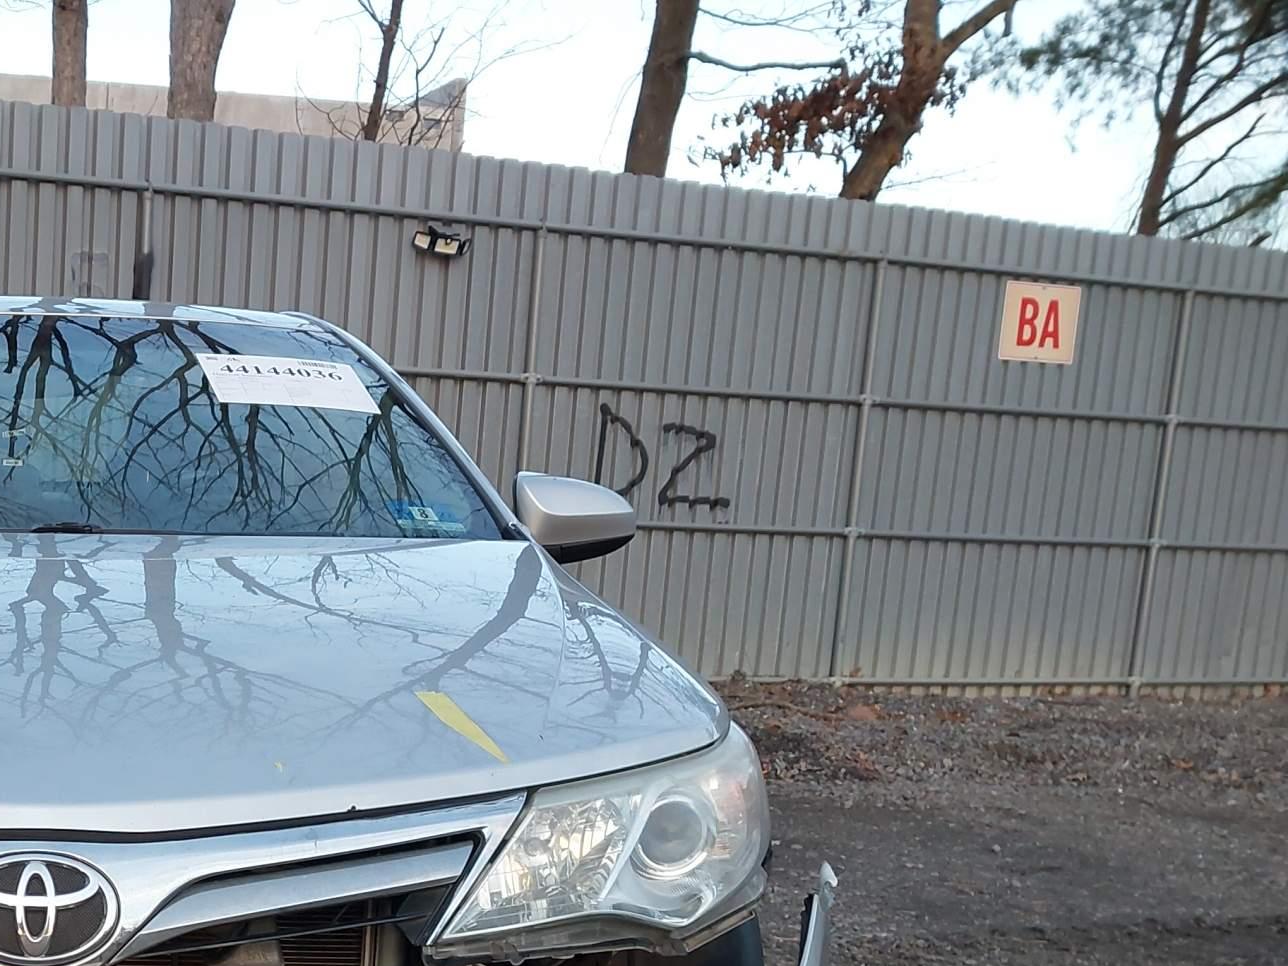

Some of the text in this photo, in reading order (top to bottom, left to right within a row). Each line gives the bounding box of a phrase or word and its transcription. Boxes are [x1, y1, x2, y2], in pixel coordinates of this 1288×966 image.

[1016, 297, 1060, 349] BA
[220, 363, 343, 382] 44144036
[594, 403, 731, 511] DZ
